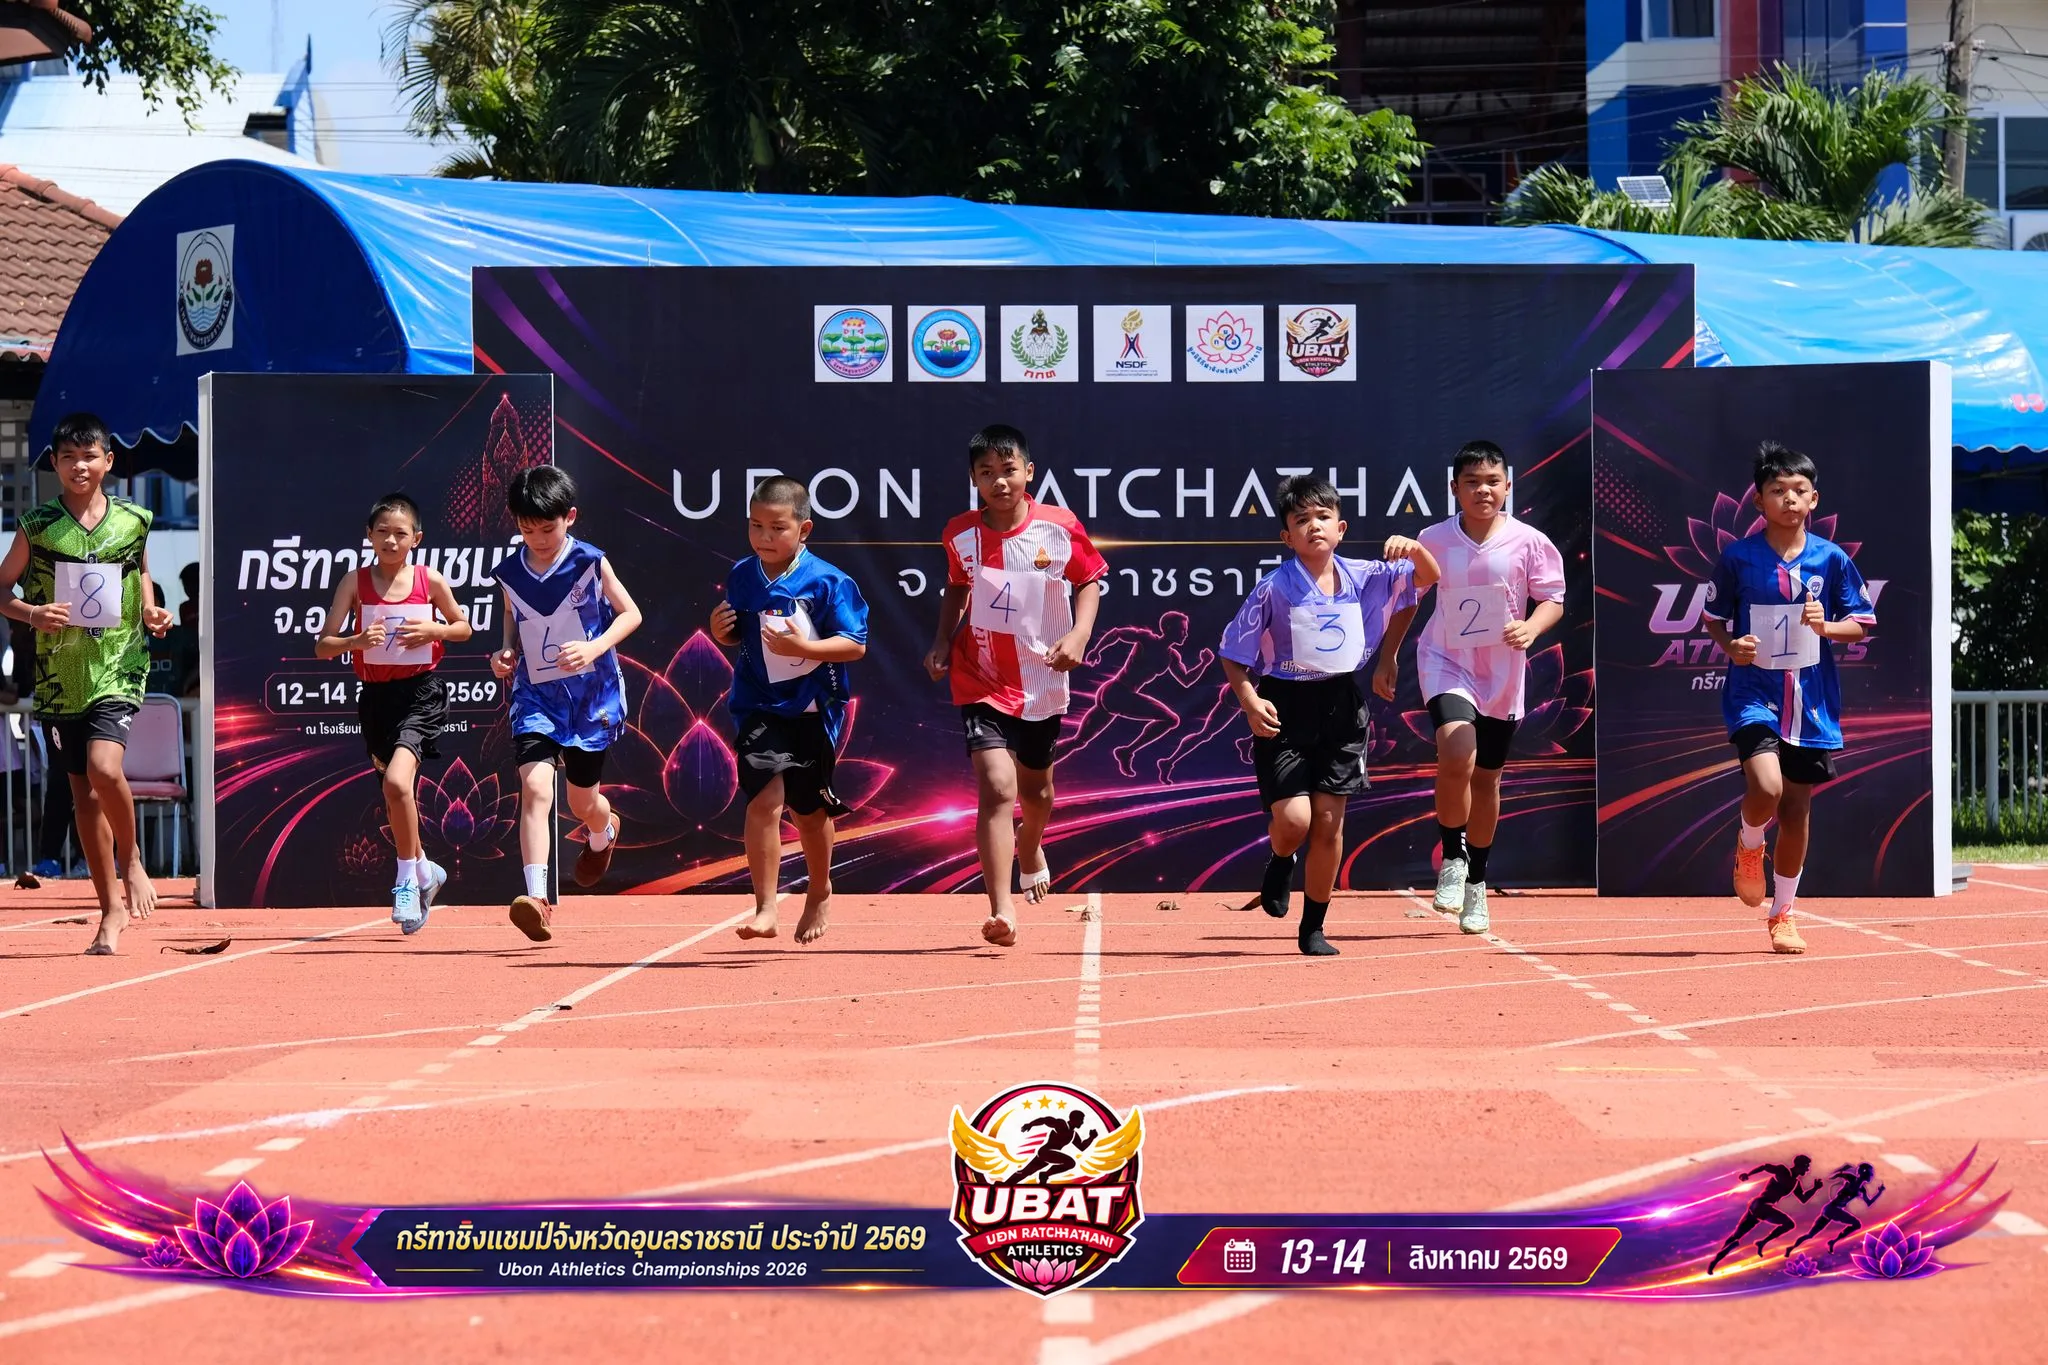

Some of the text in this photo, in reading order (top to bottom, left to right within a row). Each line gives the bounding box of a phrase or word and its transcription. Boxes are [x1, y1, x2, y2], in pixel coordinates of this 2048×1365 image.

[1115, 360, 1148, 369] NSDF
[1292, 343, 1345, 357] UBAT
[79, 572, 105, 619] 8
[990, 581, 1017, 624] 4
[384, 616, 411, 652] 7
[1315, 613, 1346, 652] 3
[1459, 598, 1489, 636] 2
[1771, 614, 1798, 657] 1
[541, 626, 562, 664] 6
[446, 681, 497, 703] 2569
[305, 724, 317, 735] ณ
